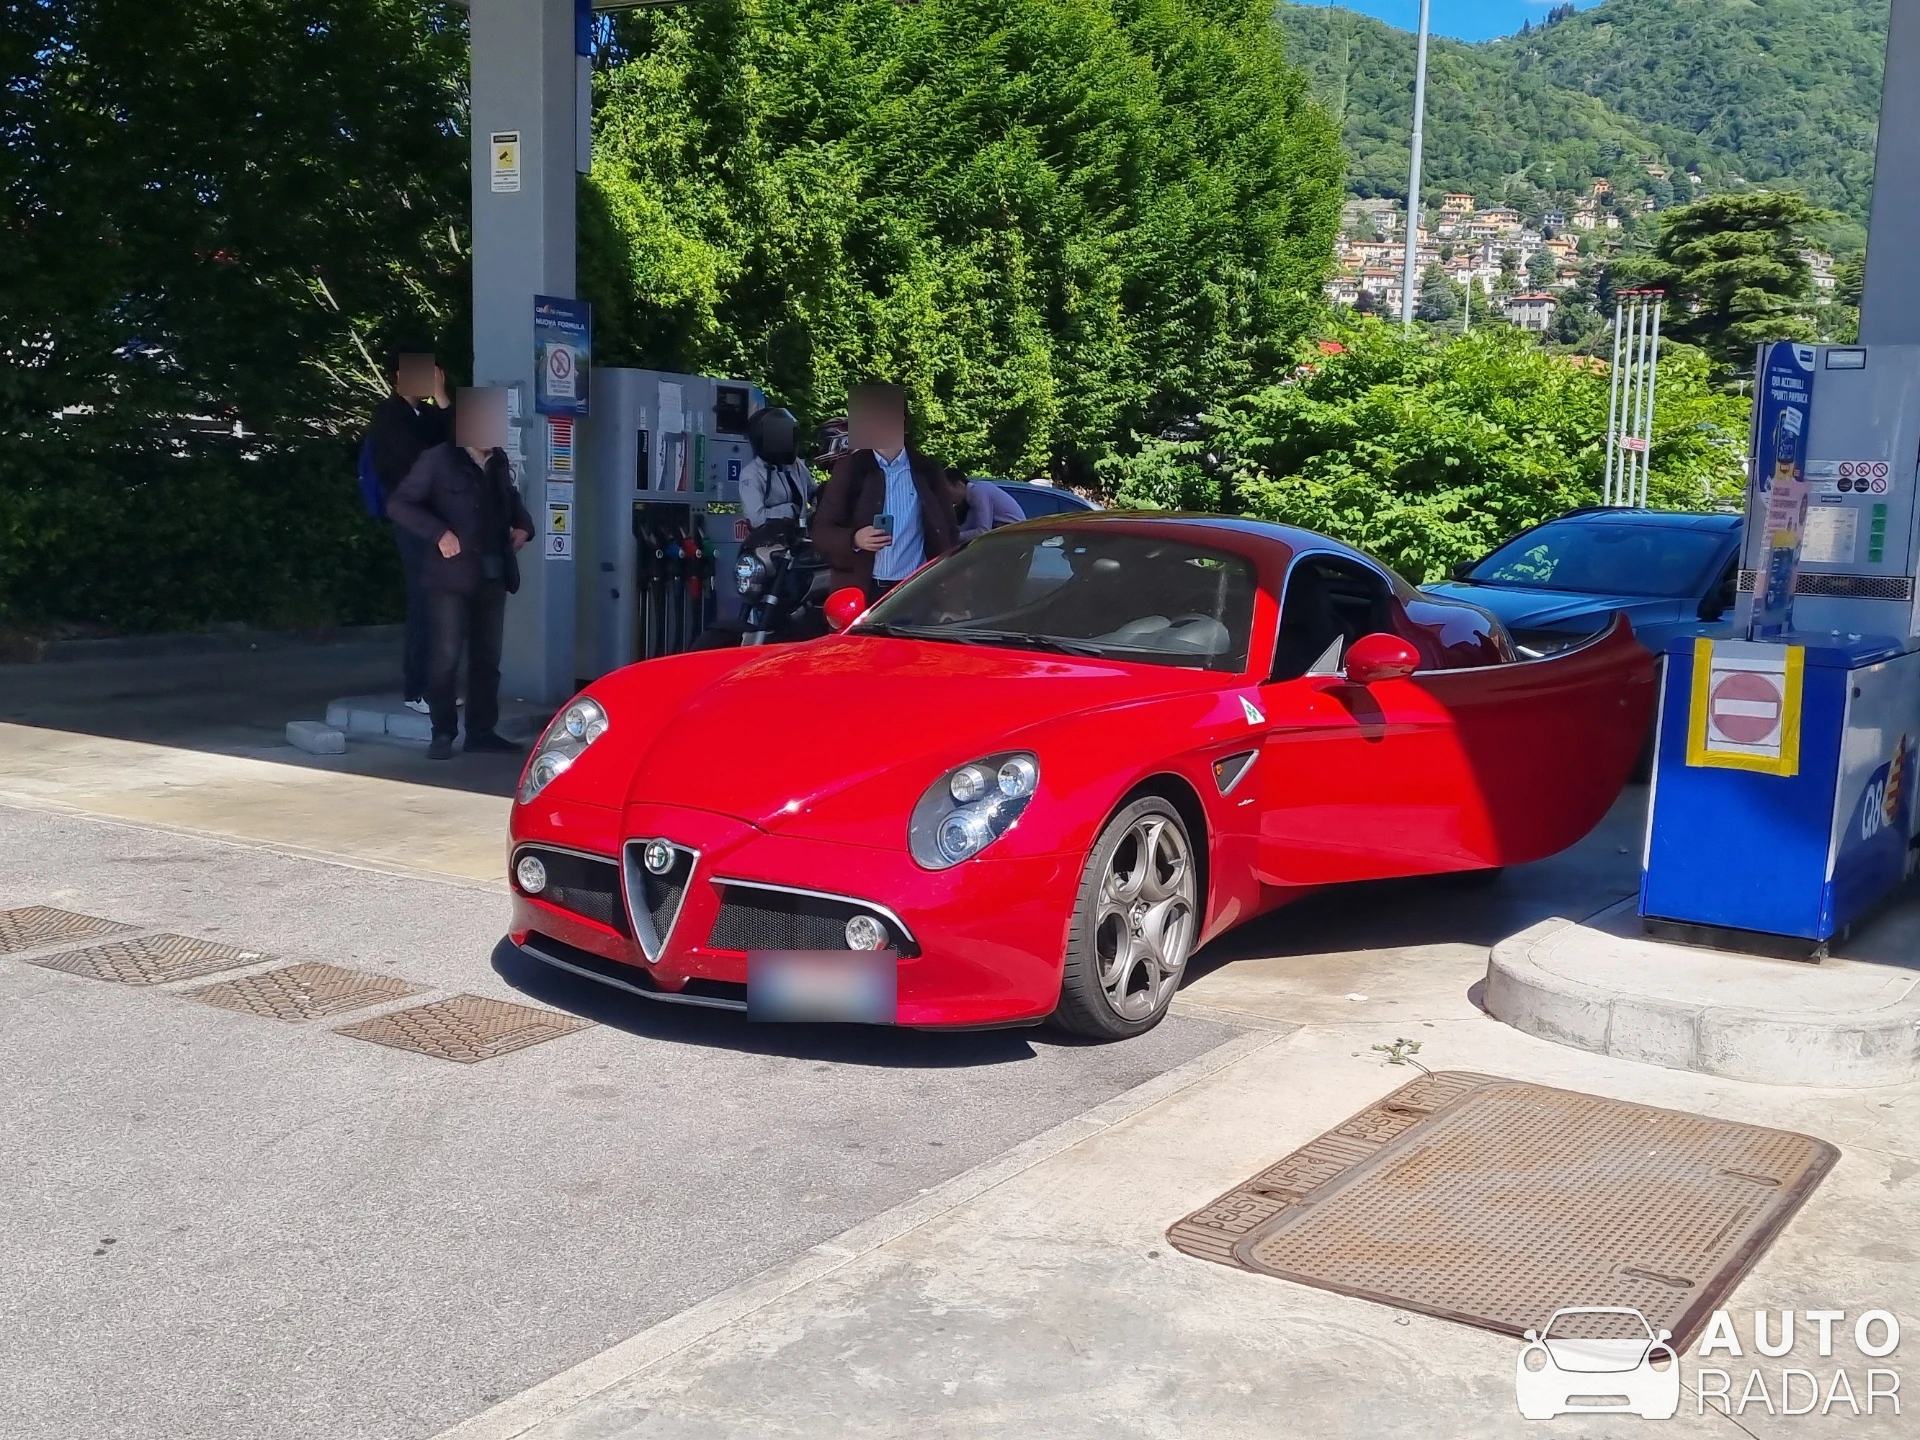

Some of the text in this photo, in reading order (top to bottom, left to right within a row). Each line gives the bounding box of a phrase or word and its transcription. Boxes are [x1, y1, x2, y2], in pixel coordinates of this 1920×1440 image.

[536, 317, 585, 330] NUOVA FORMULA
[731, 465, 737, 477] 3
[1862, 779, 1883, 840] Q8
[1214, 1196, 1263, 1222] EASY
